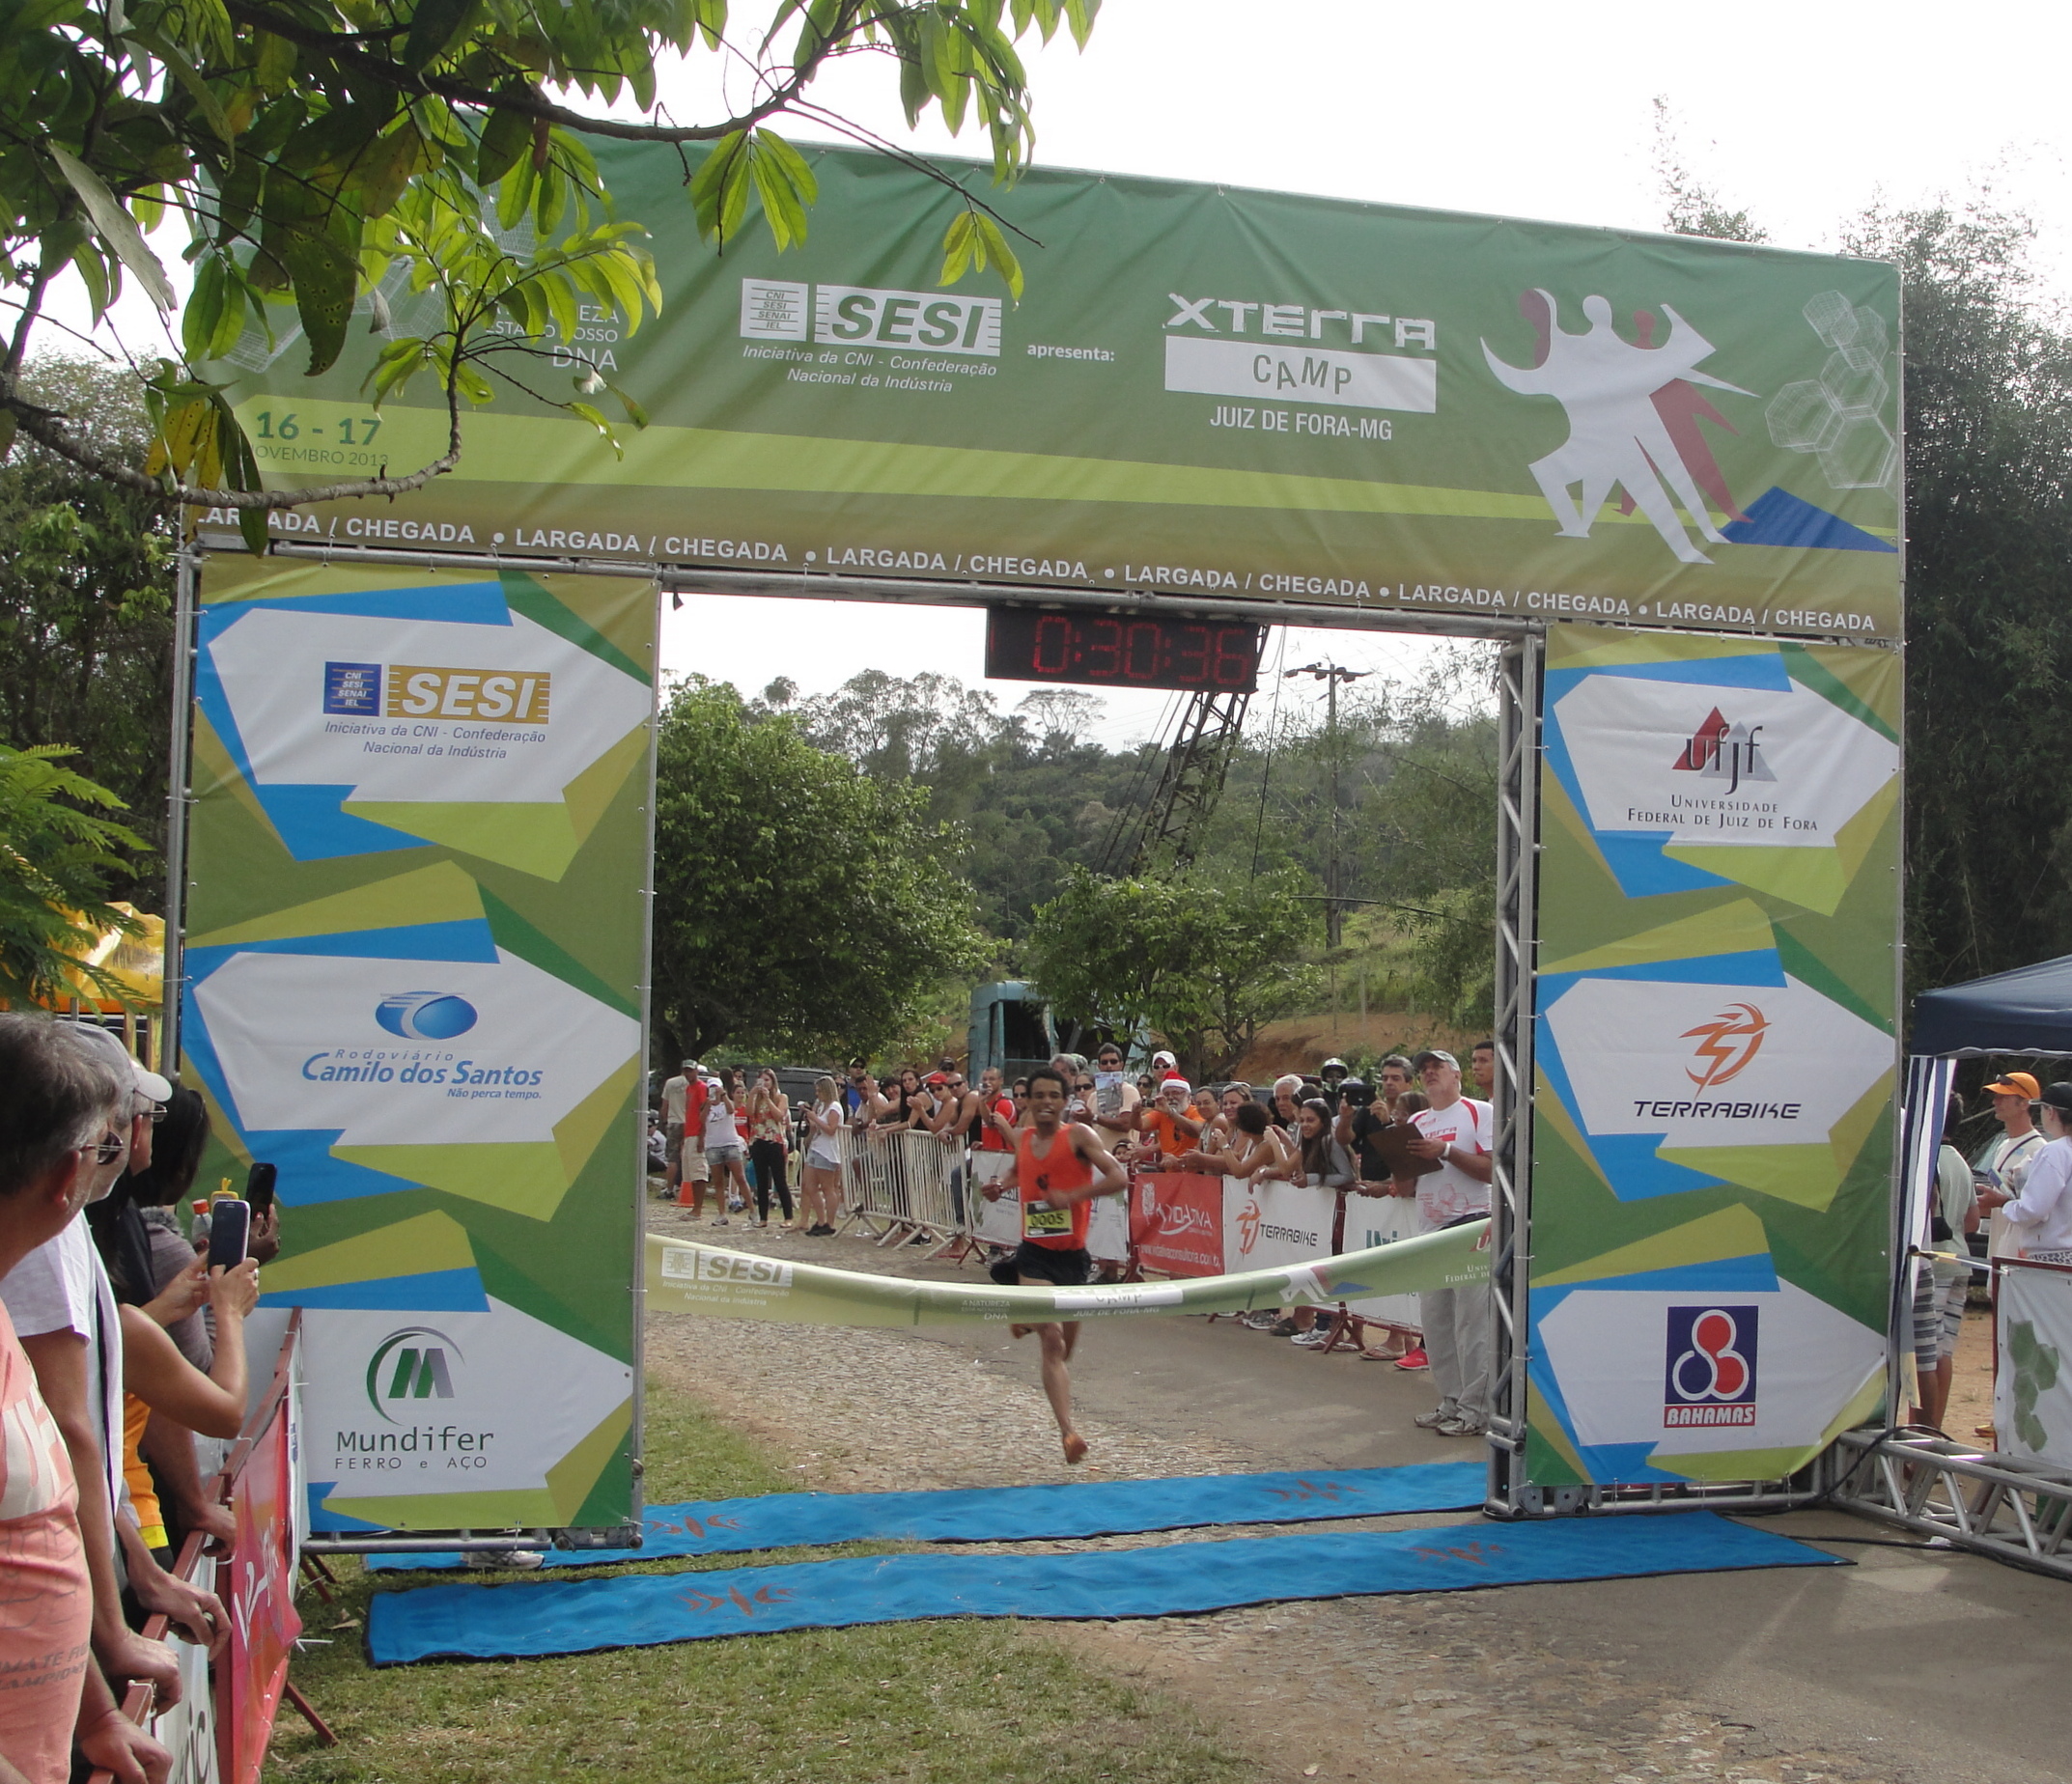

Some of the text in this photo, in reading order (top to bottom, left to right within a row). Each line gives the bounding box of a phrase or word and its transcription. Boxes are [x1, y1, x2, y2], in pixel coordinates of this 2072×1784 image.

[763, 300, 788, 310] SESI
[766, 292, 785, 300] CNI
[758, 311, 791, 321] SENAI
[831, 294, 985, 348] SESI
[1162, 293, 1437, 350] XTERRA
[561, 326, 619, 343] OSSO
[552, 345, 618, 372] DNA
[742, 345, 814, 363] Iniciativa
[819, 350, 838, 364] da
[845, 352, 874, 367] CNI
[890, 355, 997, 377] Confederação
[1027, 344, 1115, 362] apresenta:
[787, 368, 953, 393] Nacional da Indústria
[1253, 354, 1352, 395] CAMP
[257, 411, 299, 440] 16
[338, 418, 381, 446] 17
[1210, 405, 1392, 440] JUIZ DE FORA-MG
[253, 446, 388, 467] OVEMBRO 2013
[197, 507, 321, 533] ARADA
[346, 517, 475, 544] CHEGADA
[516, 528, 641, 553] LARGADA
[664, 537, 788, 562] CHEGADA
[826, 546, 947, 571] LARGADA
[969, 555, 1088, 579] CHEGADA
[1125, 564, 1238, 589] LARGADA
[1259, 573, 1371, 599] CHEGADA
[1399, 583, 1506, 606] LARGADA
[1526, 592, 1631, 615] CHEGADA
[1656, 601, 1755, 625] LARGADA
[1775, 609, 1876, 631] CHEGADA
[1032, 615, 1252, 685] 0:30:36
[338, 689, 367, 698] SENAI
[342, 680, 363, 689] SESI
[345, 698, 359, 707] IEL
[402, 672, 536, 718] SESI
[324, 721, 386, 736] Iniciativa
[391, 724, 407, 737] da
[413, 725, 439, 739] CNI
[453, 726, 546, 744] Confederação
[363, 741, 508, 760] Nacional da Indústria
[1671, 794, 1778, 813] UNIVERSIDADE
[1628, 807, 1818, 831] FEDERAL DE JUIZ DE FORA
[335, 1049, 454, 1061] Rodoviário
[301, 1052, 544, 1086] Camilo dos Santos
[447, 1088, 543, 1101] Não perca tempo.
[1634, 1101, 1802, 1119] TERRABIKE
[1260, 1223, 1318, 1246] TERRABIKE
[706, 1255, 784, 1283] SESI
[662, 1281, 697, 1291] Iniciativa
[684, 1293, 718, 1302] Nacional
[984, 1312, 1008, 1321] DNA
[1666, 1407, 1754, 1425] BAHAMAS
[336, 1426, 494, 1452] Mundifer
[335, 1456, 487, 1470] FERRO e AÇO
